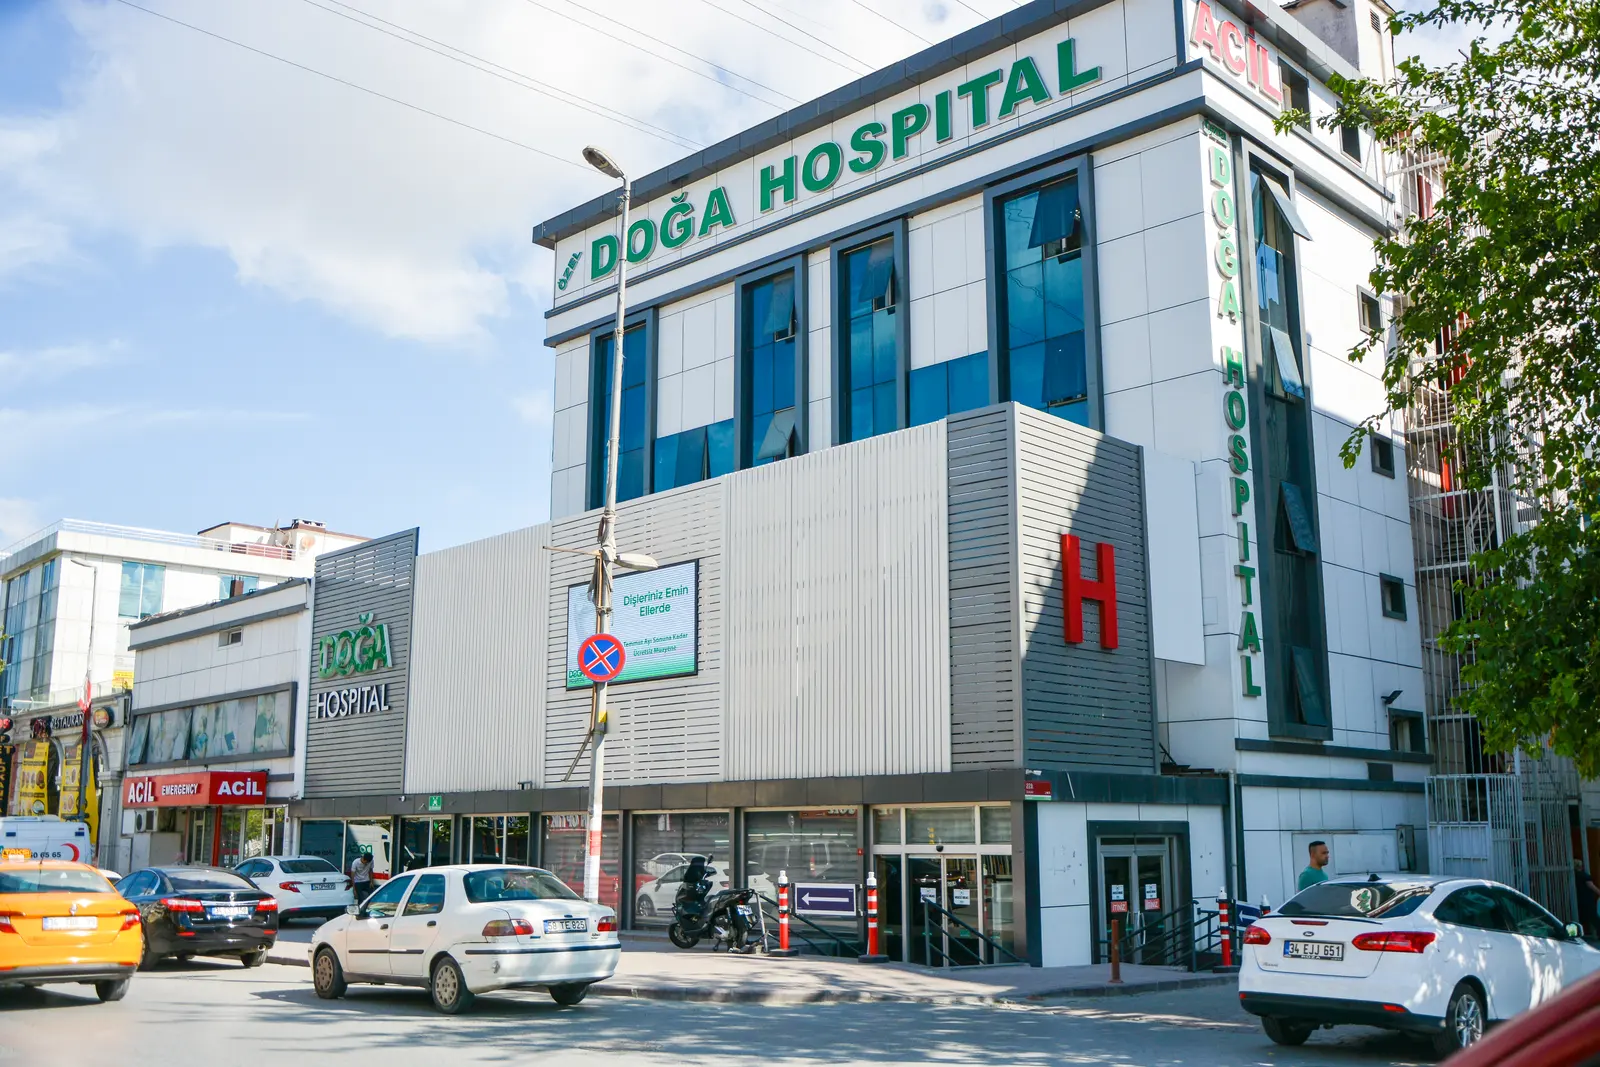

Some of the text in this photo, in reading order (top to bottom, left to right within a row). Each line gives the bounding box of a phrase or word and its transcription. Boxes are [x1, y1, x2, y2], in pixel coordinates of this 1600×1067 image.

[1190, 0, 1282, 105] ACİL
[557, 38, 1102, 291] ÖZEL DOĞA HOSPITAL
[1209, 146, 1241, 326] DOĞA
[1220, 346, 1262, 698] HOSPITAL
[624, 585, 688, 607] Dişleriniz Emin
[1061, 534, 1119, 649] H
[639, 603, 671, 617] Ellerde
[319, 612, 393, 679] DOĞA
[316, 684, 390, 719] HOSPITAL
[128, 776, 198, 803] ACİL EMERGENCY
[217, 778, 263, 796] ACİL
[547, 920, 585, 930] 58 TE 825
[1289, 943, 1340, 957] 34 EJJ 651
